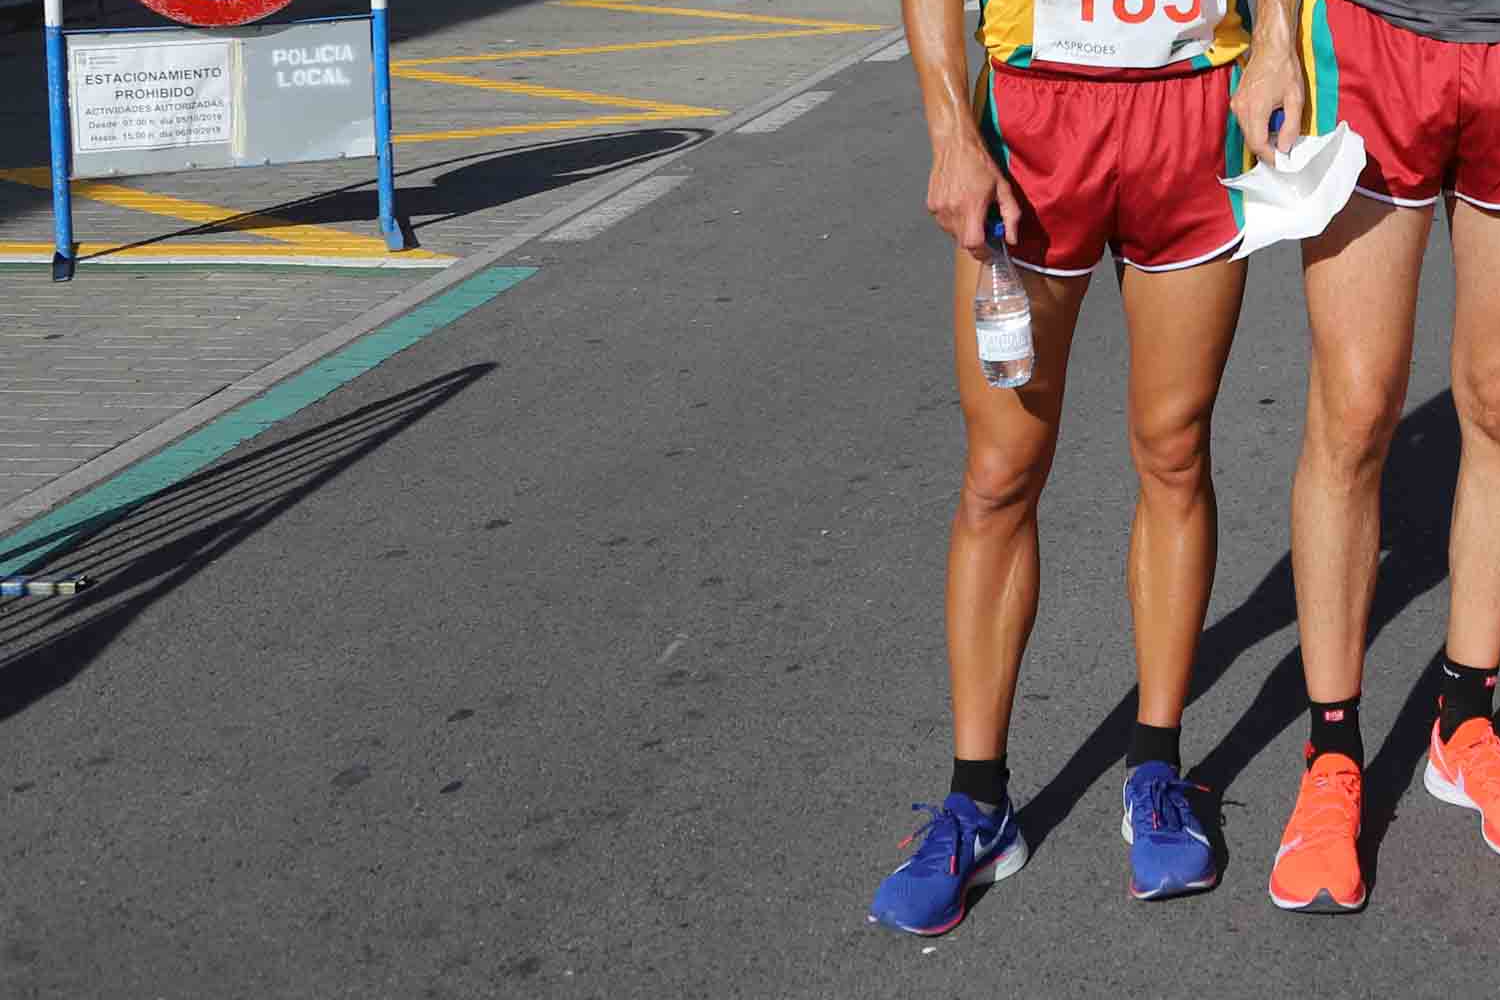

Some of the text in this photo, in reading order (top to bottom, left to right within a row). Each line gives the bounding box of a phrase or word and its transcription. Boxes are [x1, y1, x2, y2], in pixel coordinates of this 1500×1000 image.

[272, 44, 353, 66] POLICIA
[1055, 39, 1116, 55] ASPRODES
[85, 66, 222, 85] ESTACIONAMIENTO
[276, 67, 351, 87] LOCAL
[115, 86, 194, 100] PROHIBIDO
